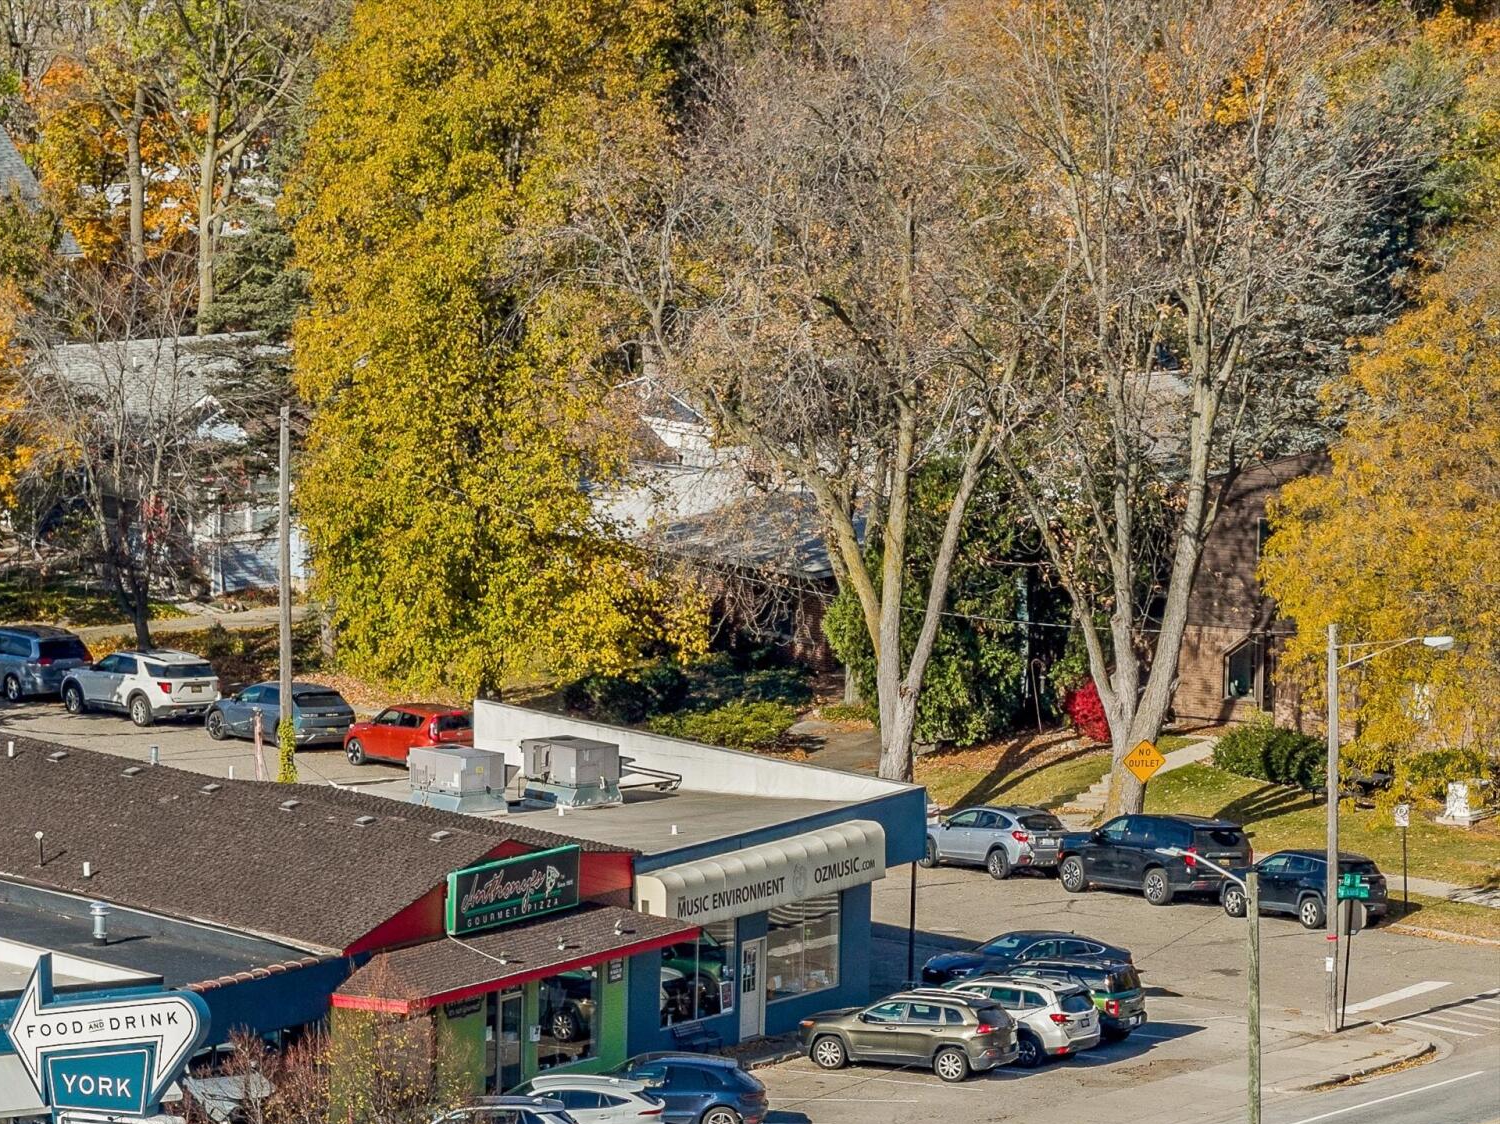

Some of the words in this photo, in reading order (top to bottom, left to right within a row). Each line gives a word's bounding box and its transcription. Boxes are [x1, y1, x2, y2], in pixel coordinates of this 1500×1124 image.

[1128, 759, 1159, 768] OUTLET
[1138, 748, 1151, 756] NO
[461, 868, 546, 914] Anthony's
[677, 895, 709, 918] MUSIC
[712, 877, 785, 910] ENVIRONMENT
[467, 907, 517, 928] GOURMET
[527, 898, 559, 911] PIZZA
[26, 1020, 83, 1038] FOOD
[88, 1021, 104, 1030] AND
[109, 1011, 179, 1031] DRINK
[61, 1073, 132, 1098] YORK
